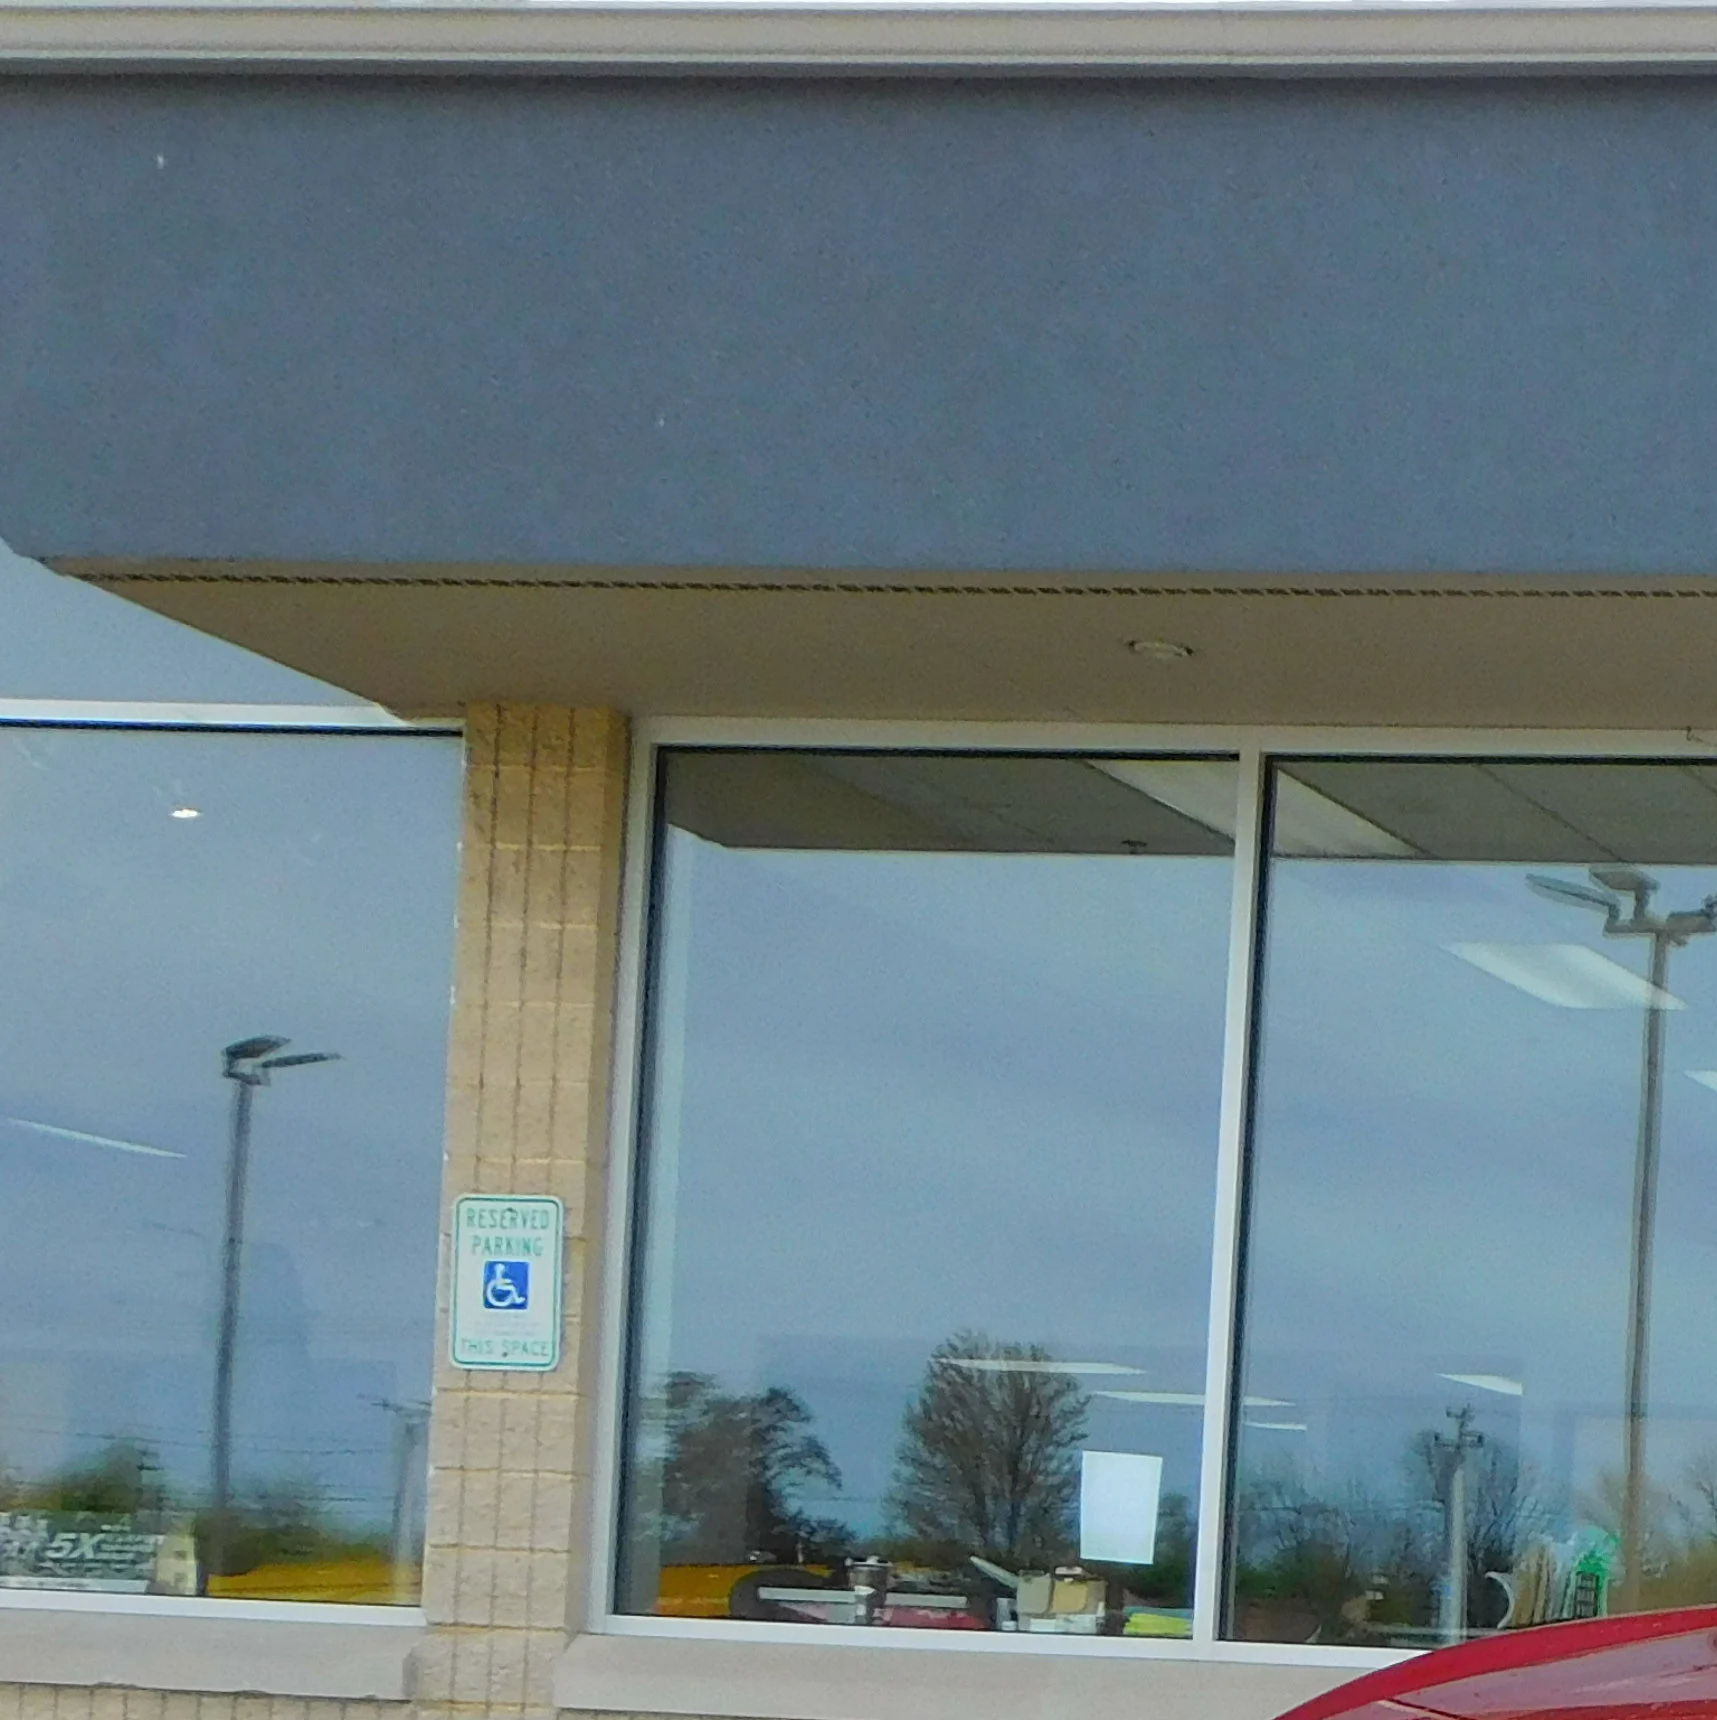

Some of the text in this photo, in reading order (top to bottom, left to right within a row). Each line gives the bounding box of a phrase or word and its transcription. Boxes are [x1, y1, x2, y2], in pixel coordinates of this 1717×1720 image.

[466, 1207, 549, 1230] RESERVED
[471, 1235, 544, 1257] PARKING
[460, 1338, 550, 1358] THIS SPACE
